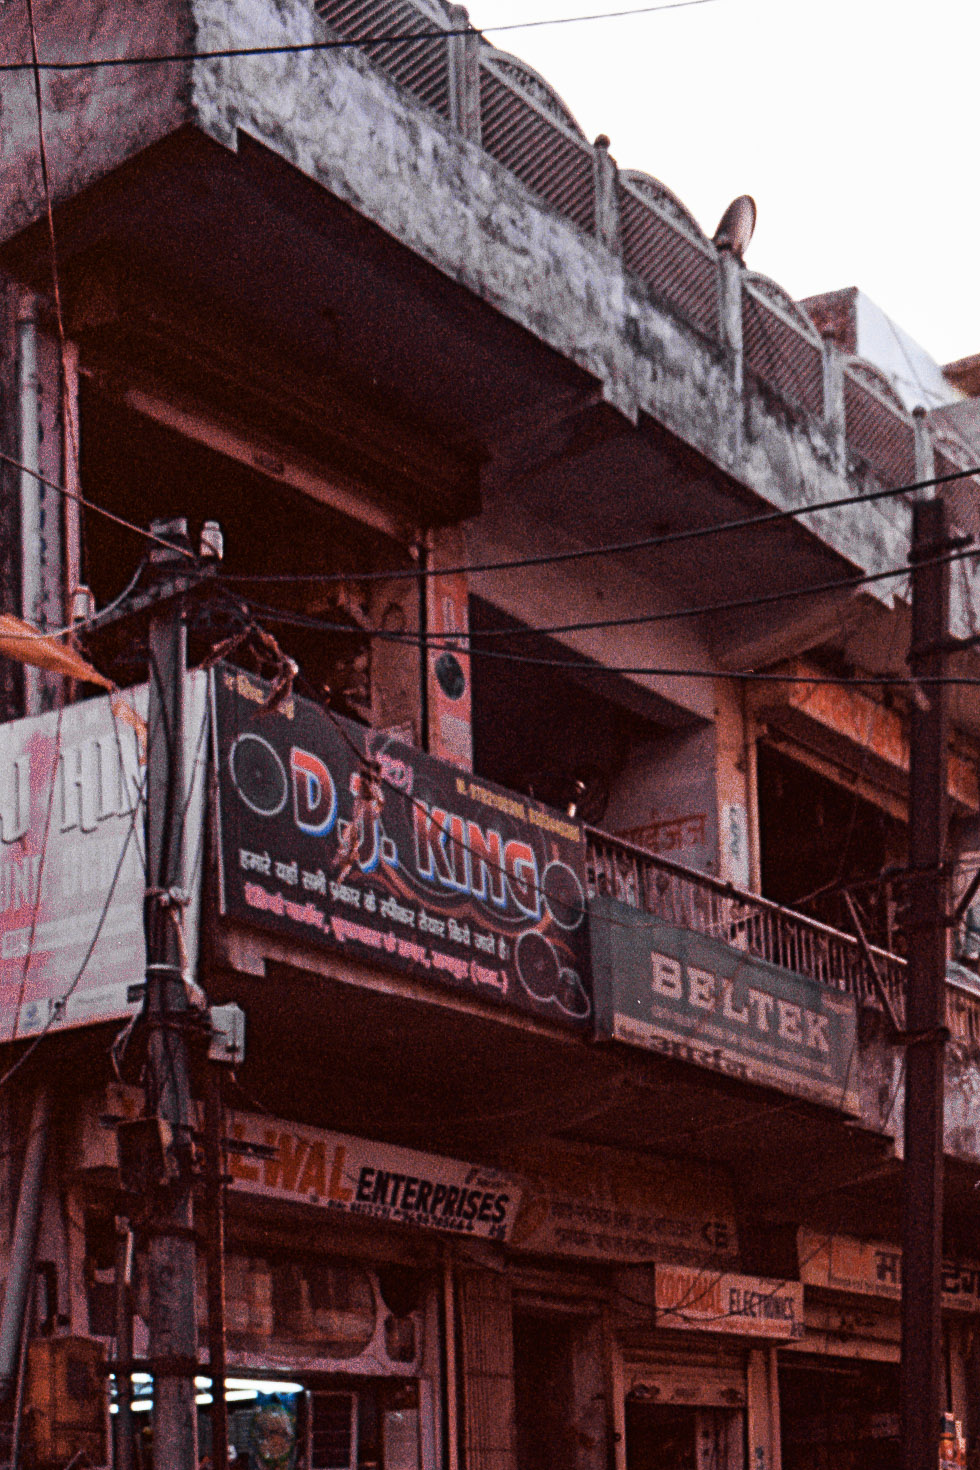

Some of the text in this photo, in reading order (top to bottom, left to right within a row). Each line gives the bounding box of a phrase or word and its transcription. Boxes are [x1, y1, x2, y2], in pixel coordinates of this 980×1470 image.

[239, 847, 272, 877] हमारे
[329, 880, 361, 910] प्रकार
[363, 889, 377, 914] के
[413, 797, 542, 922] KING
[651, 950, 831, 1053] BELTEK
[357, 1166, 510, 1223] ENTERPRISES
[729, 1287, 796, 1320] ELECTRONICS
